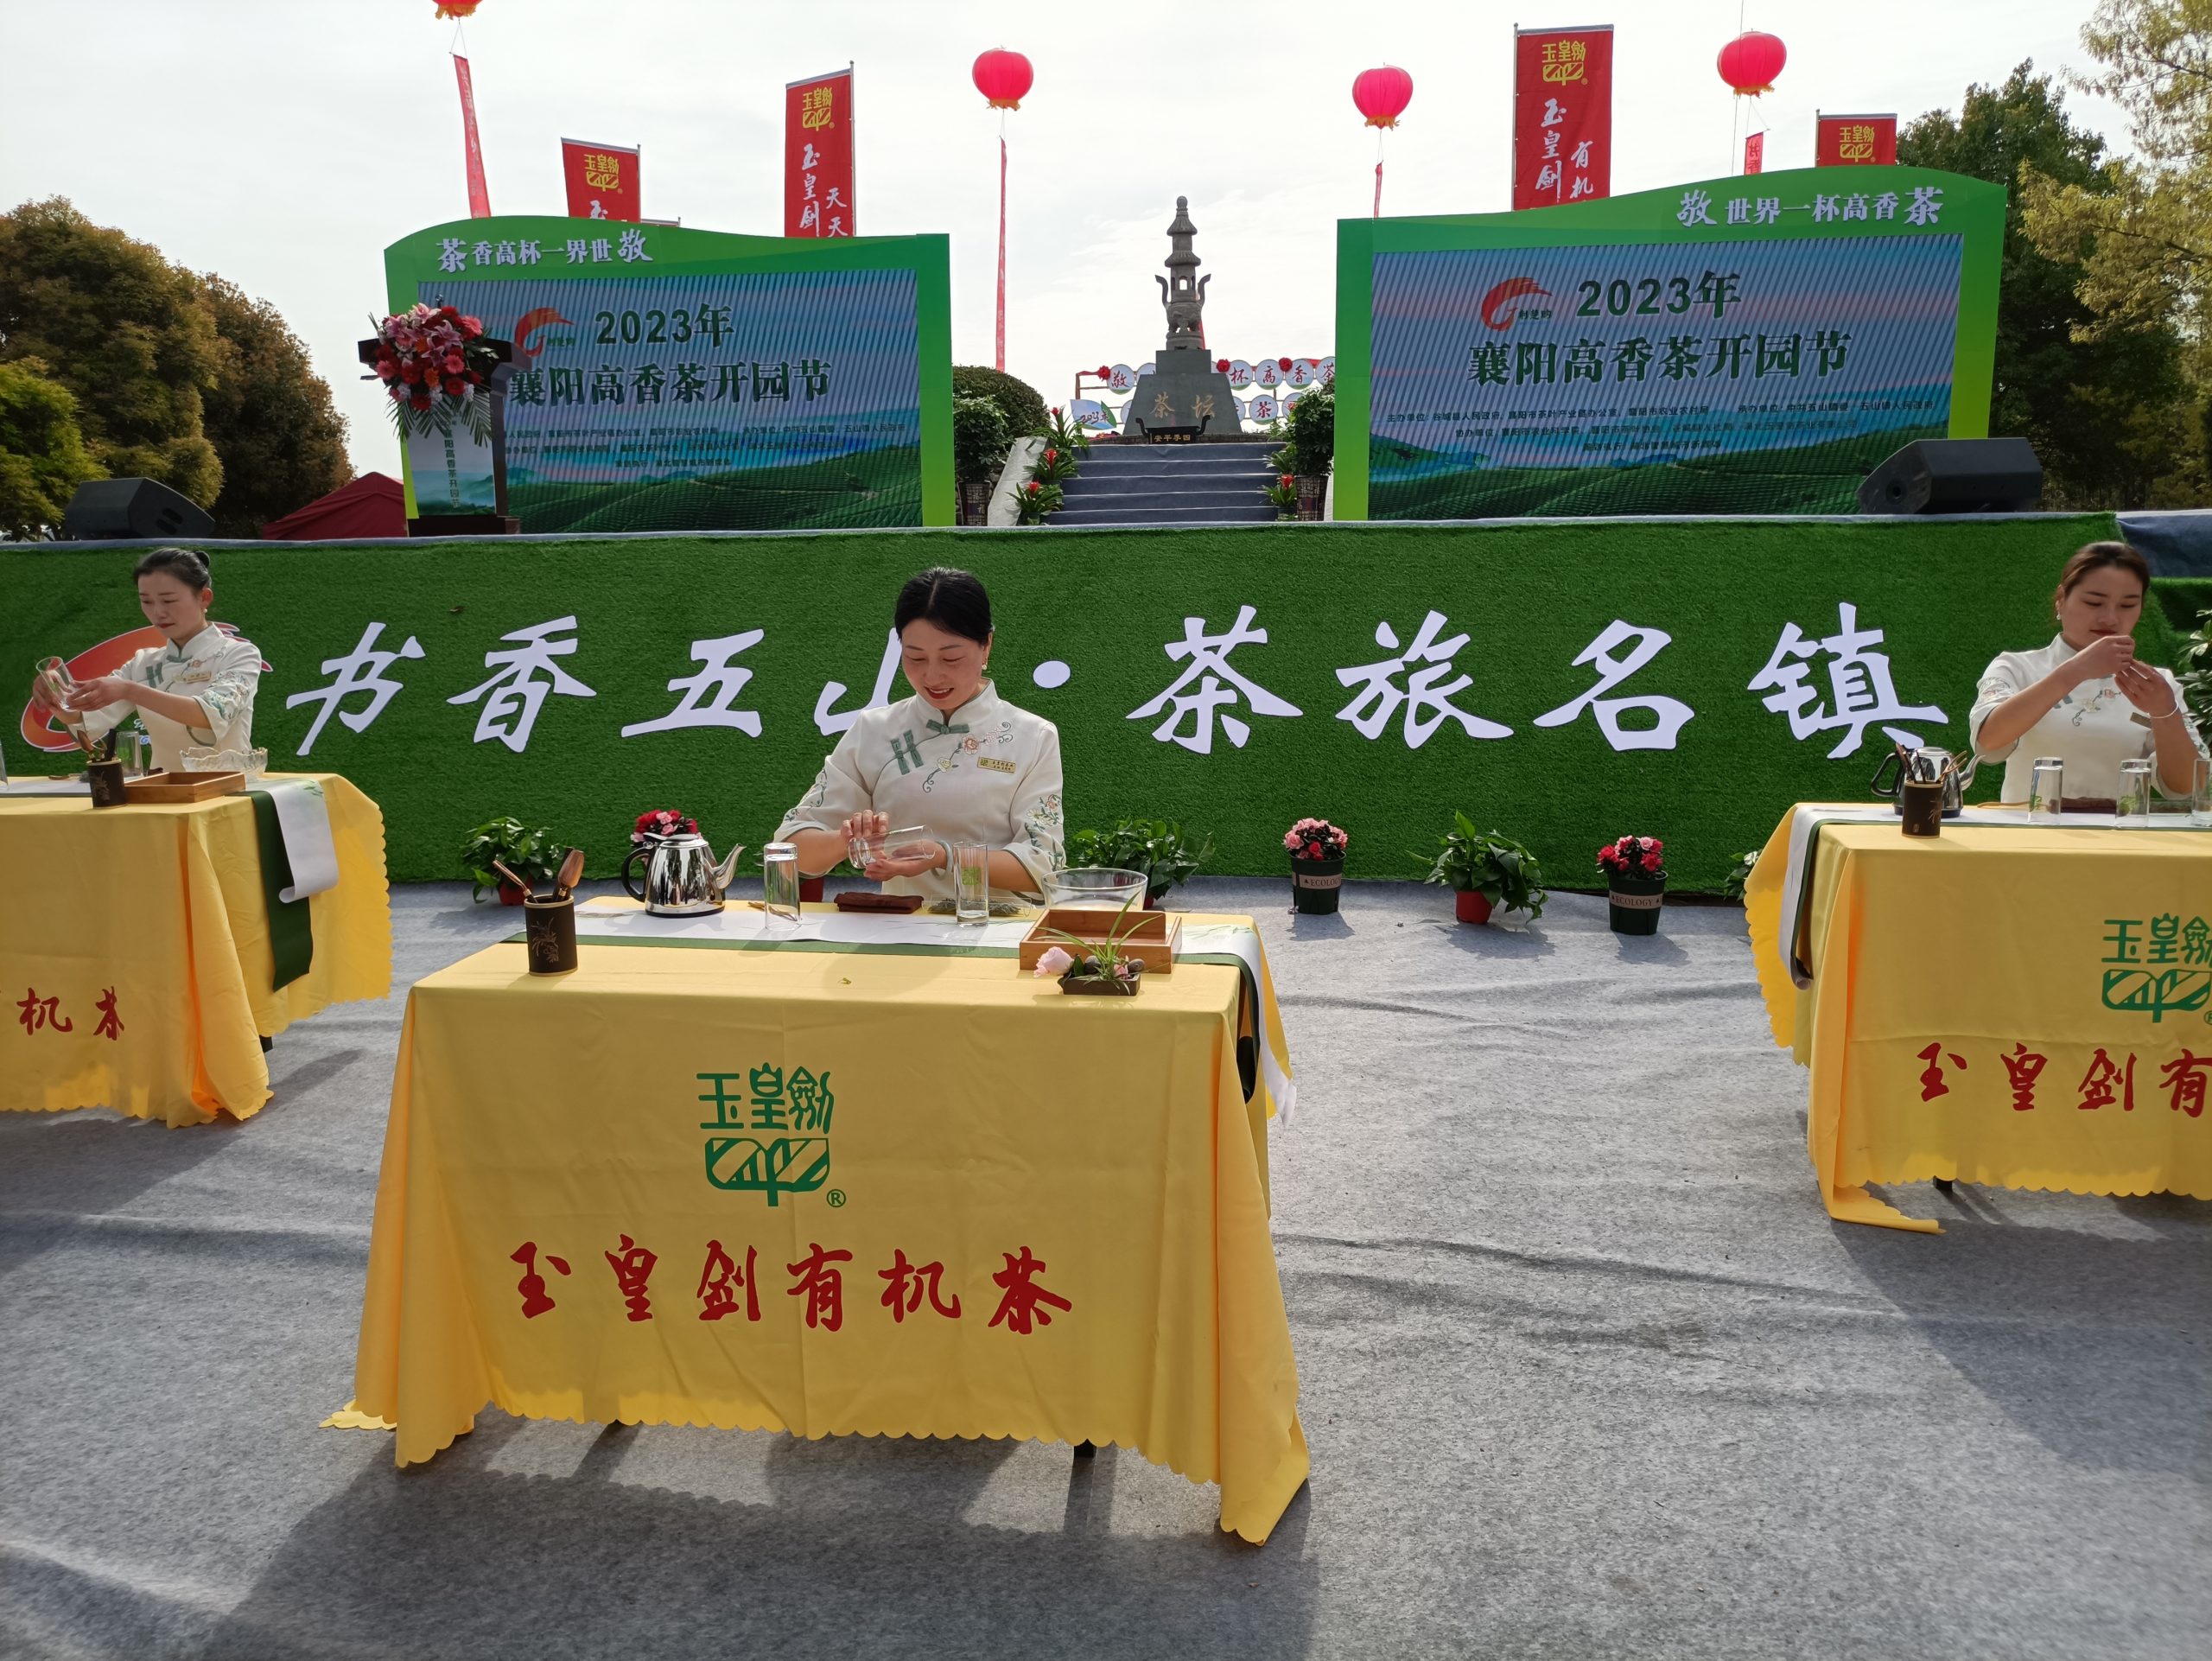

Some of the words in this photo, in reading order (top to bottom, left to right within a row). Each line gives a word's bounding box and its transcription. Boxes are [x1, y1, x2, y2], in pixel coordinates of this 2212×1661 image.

[1676, 187, 1944, 227] 敬世界一杯高香茶
[1575, 270, 1742, 320] 2023年
[594, 302, 735, 348] 2023年
[510, 358, 832, 408] 襄阳高香茶开园节
[1467, 329, 1853, 387] 襄阳高香茶开园节
